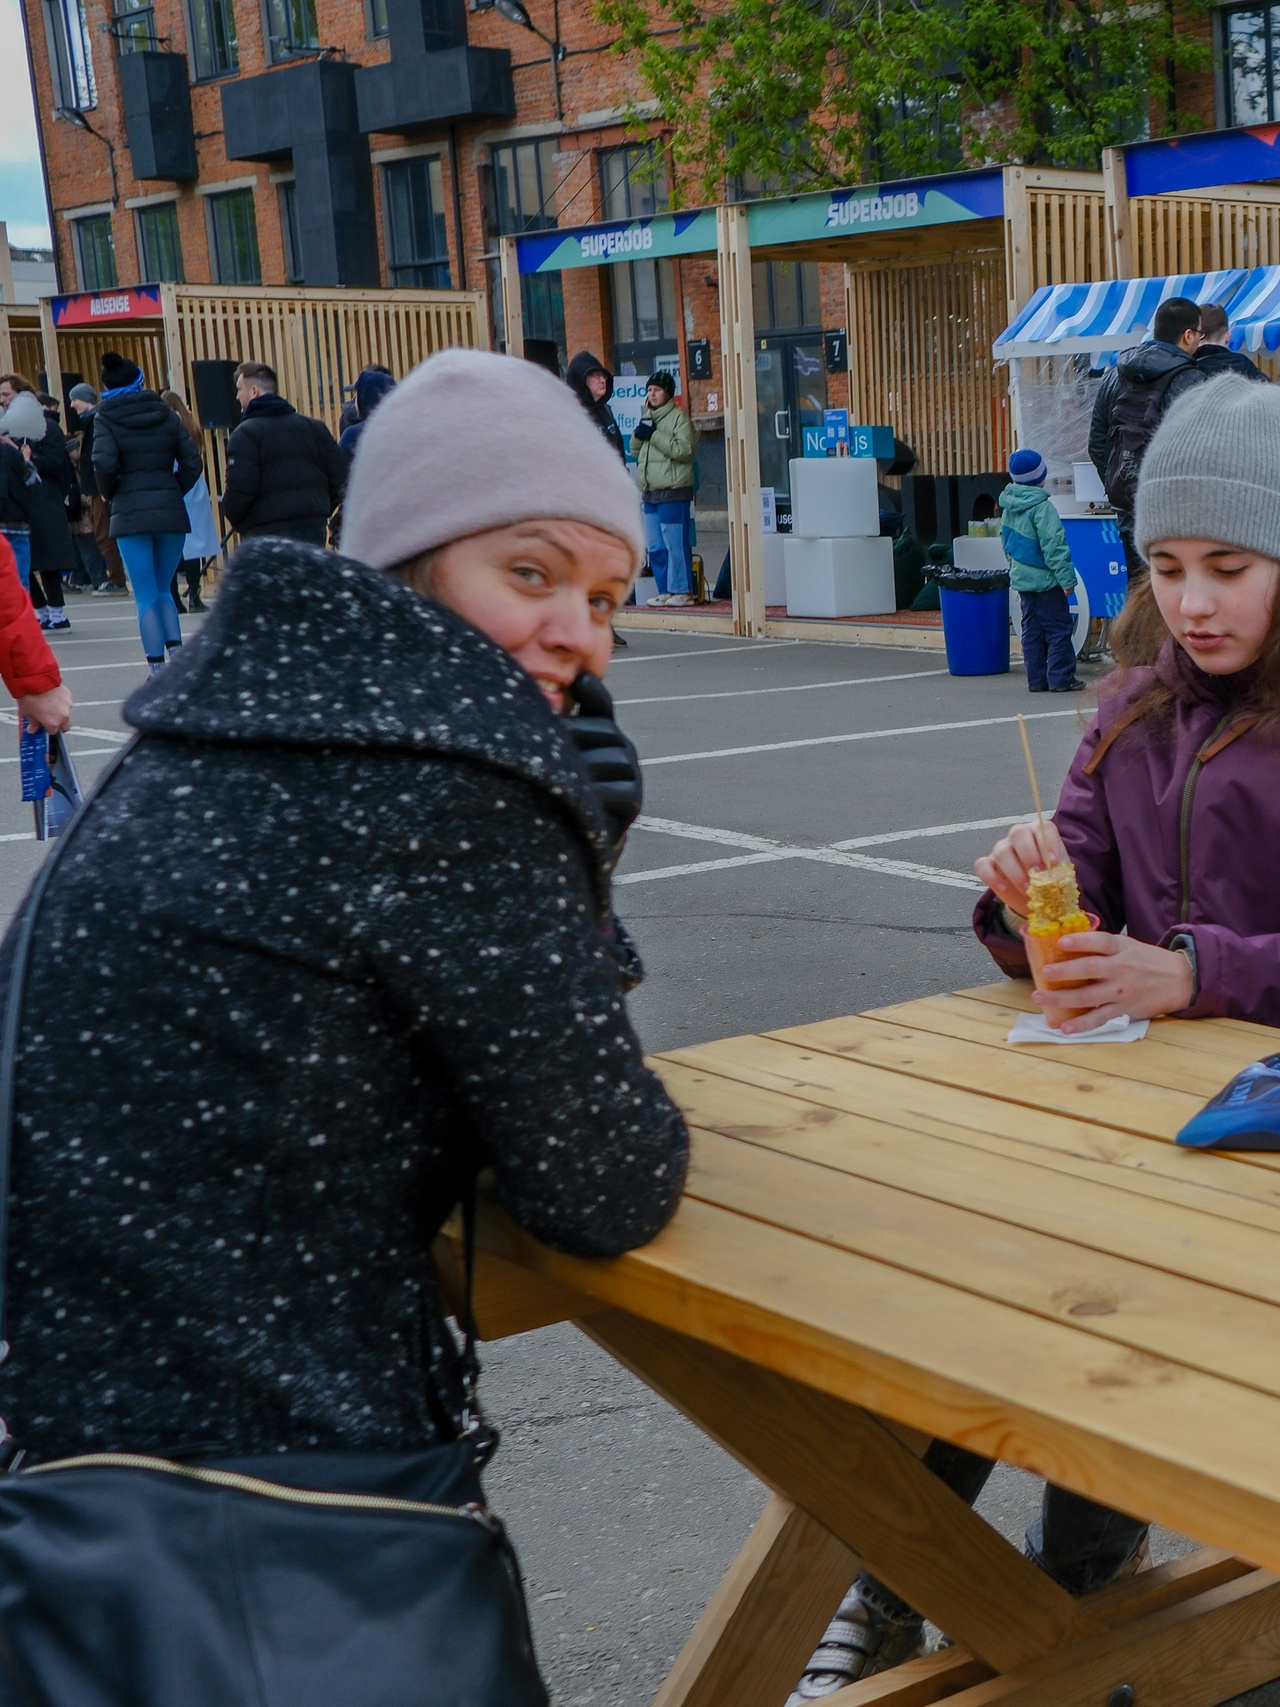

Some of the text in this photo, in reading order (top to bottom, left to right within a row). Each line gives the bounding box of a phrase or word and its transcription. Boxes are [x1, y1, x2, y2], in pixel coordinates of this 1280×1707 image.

[827, 192, 919, 227] SUPERJOB
[580, 227, 653, 258] SUPERJOB
[90, 295, 131, 316] ABISENSE
[695, 349, 703, 365] 6
[832, 340, 840, 357] 7
[611, 383, 648, 398] erJo
